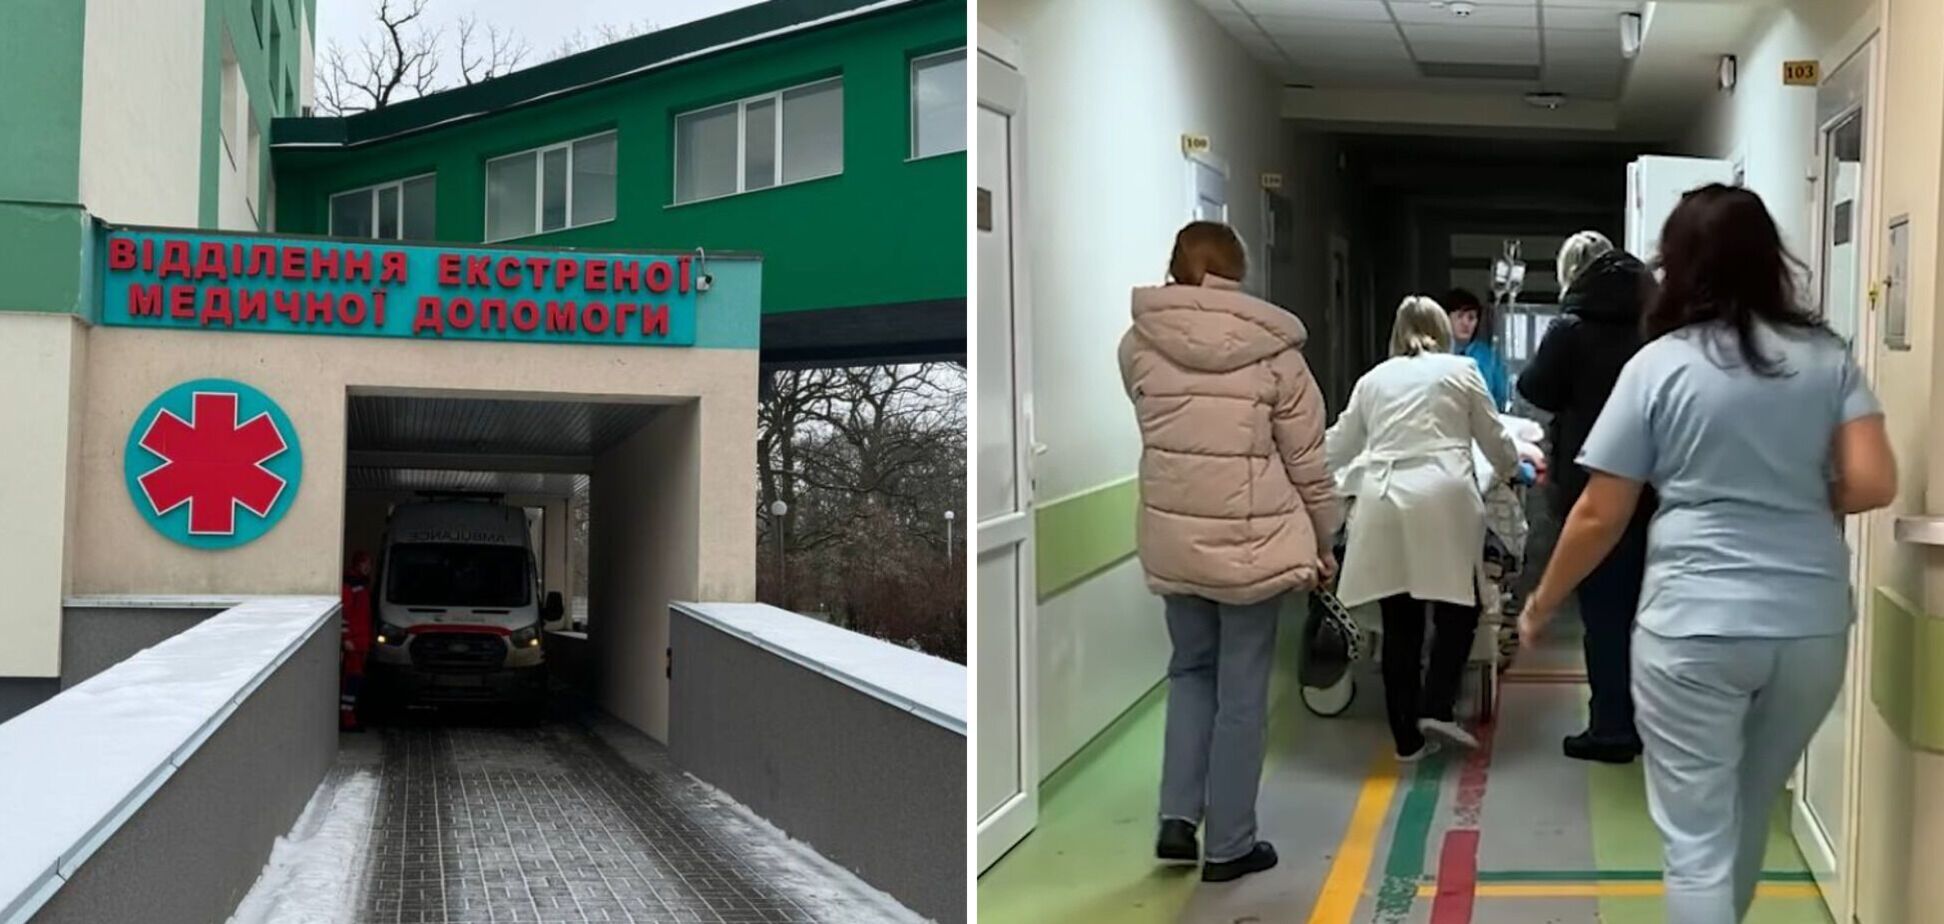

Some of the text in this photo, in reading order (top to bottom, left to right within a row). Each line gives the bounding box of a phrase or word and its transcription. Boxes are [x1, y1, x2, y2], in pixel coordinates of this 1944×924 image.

[1787, 66, 1814, 79] 103
[109, 238, 690, 293] ВІДДІЛЕННЯ ЕКСТРЕНОЇ
[128, 284, 669, 335] МЕДИЧНОЇ ДОПОМОГИ
